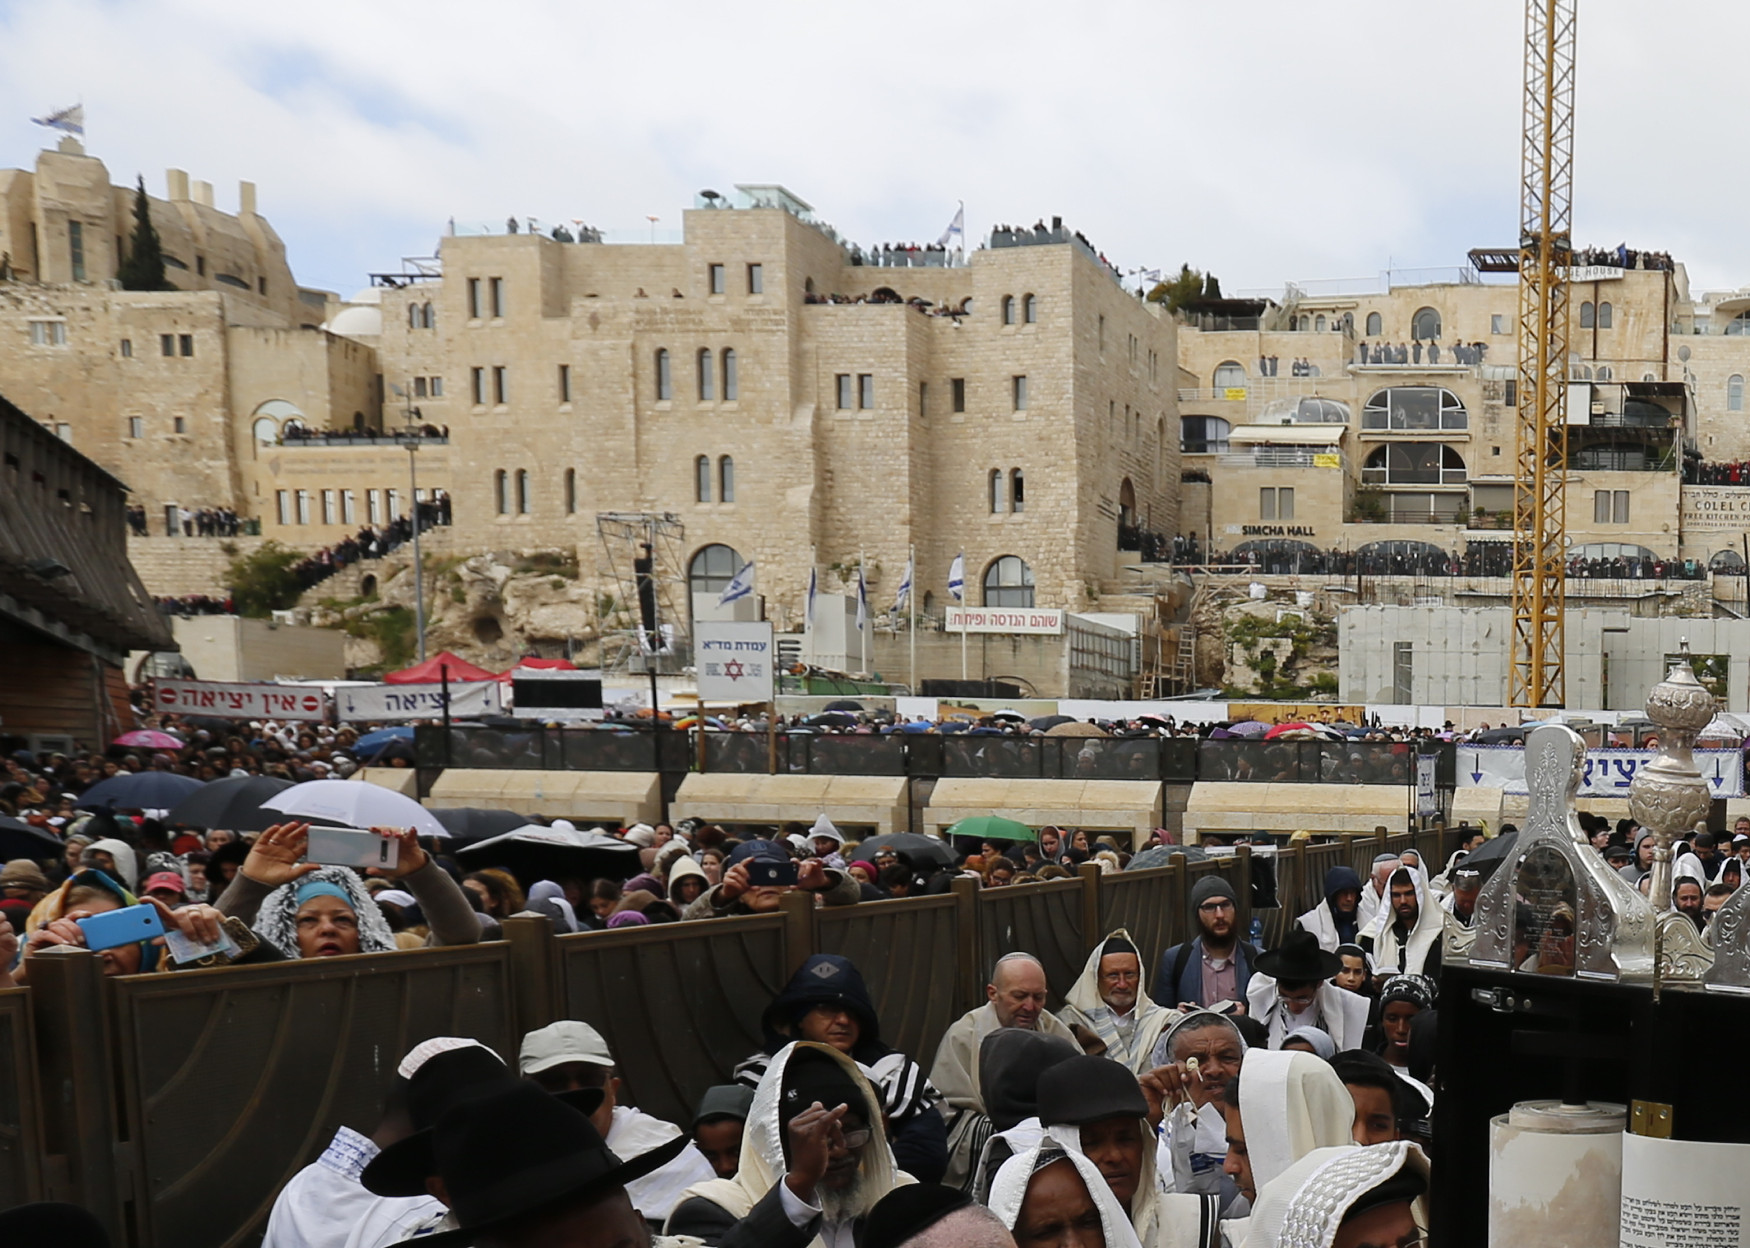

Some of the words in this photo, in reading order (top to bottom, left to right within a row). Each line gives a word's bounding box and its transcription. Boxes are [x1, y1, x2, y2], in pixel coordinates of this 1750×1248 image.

[1695, 501, 1734, 511] COLEL
[1706, 513, 1739, 521] KITCHEN
[1242, 525, 1285, 536] SIMCHA
[1287, 526, 1316, 536] HALL
[991, 614, 1025, 627] הנדסה
[1030, 615, 1058, 627] שוהם
[735, 641, 767, 652] עמדת
[182, 689, 253, 709] יציאה
[262, 694, 297, 714] אין
